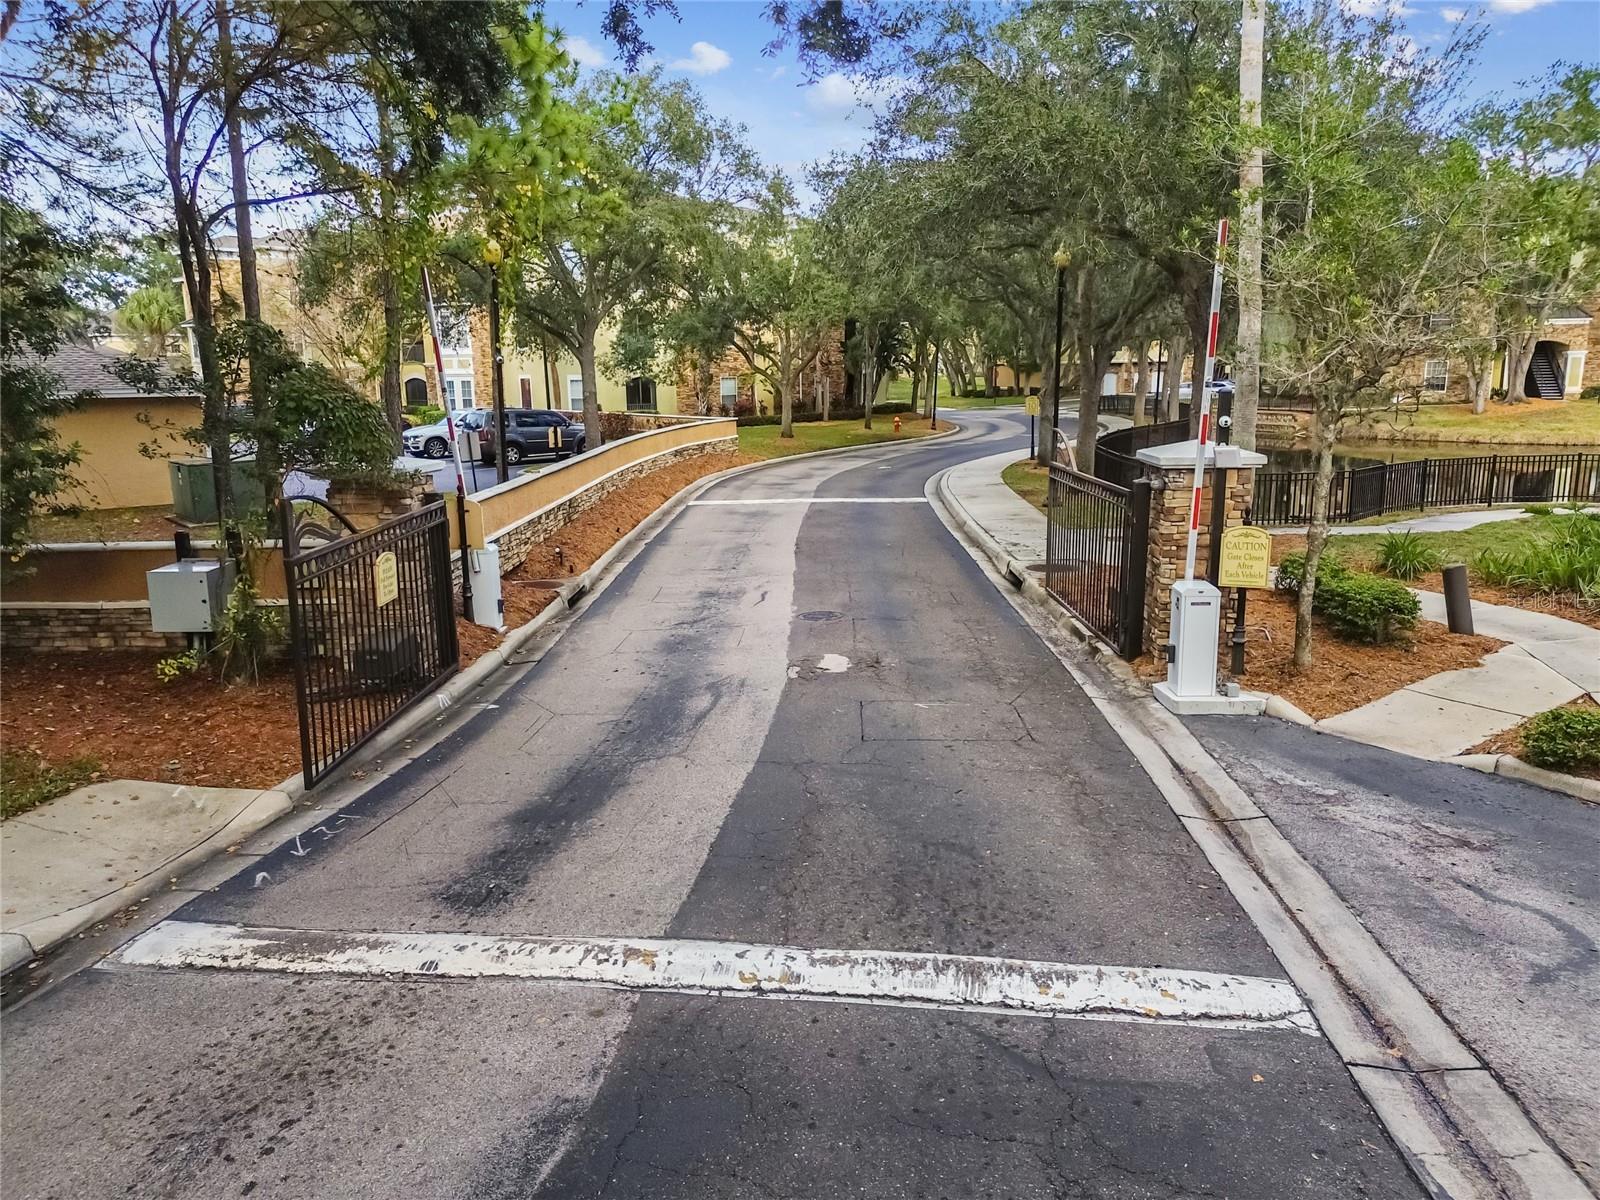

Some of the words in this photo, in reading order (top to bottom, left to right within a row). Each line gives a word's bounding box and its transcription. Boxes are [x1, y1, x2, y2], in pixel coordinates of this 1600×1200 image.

[1225, 541, 1267, 551] CAUTION
[1244, 553, 1264, 561] Closes
[1237, 562, 1253, 570] After
[1225, 570, 1239, 578] Each
[1241, 571, 1264, 579] Vehicle
